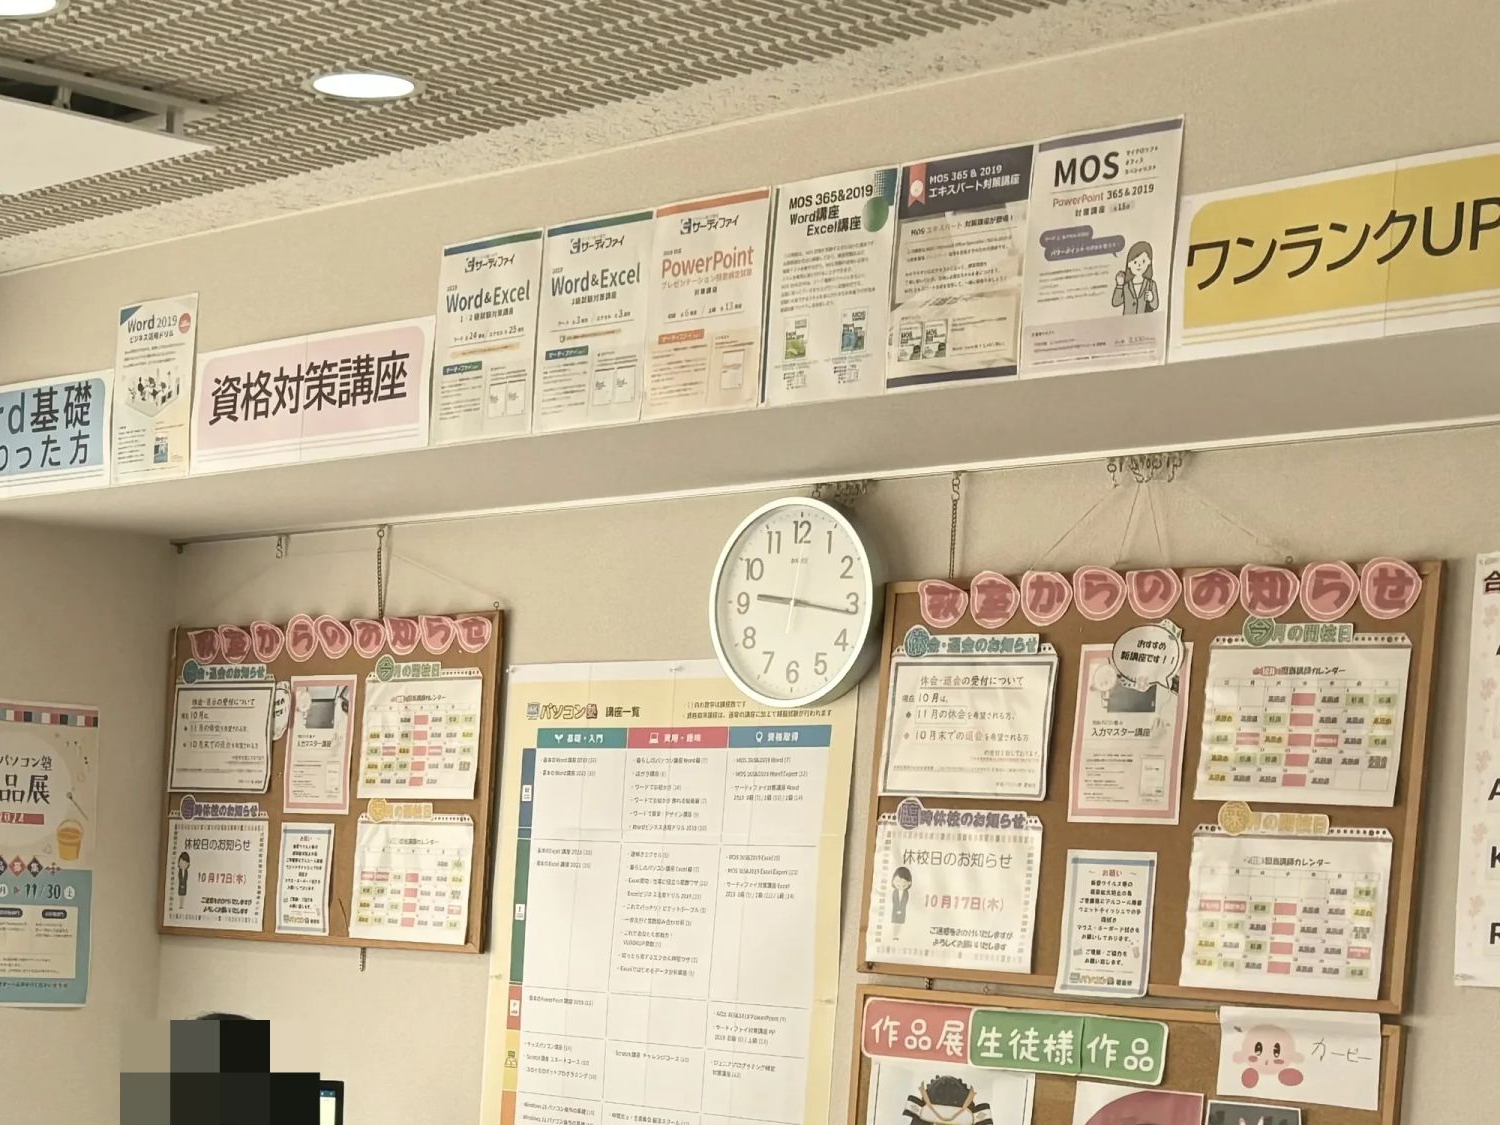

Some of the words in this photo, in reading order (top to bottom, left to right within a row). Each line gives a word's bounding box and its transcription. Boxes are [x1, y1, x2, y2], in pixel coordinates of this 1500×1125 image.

[930, 173, 949, 185] MOS
[951, 170, 968, 181] 365
[980, 164, 1003, 177] 2019
[1054, 151, 1119, 187] MOS
[789, 195, 813, 210] MOS
[815, 184, 874, 206] 365&2019
[928, 174, 1020, 198] エキスパート対策講座
[1053, 192, 1104, 208] PowerPoint
[1107, 183, 1154, 200] 365&2019
[692, 214, 740, 233] サーティファイ
[790, 205, 840, 226] Word講座
[806, 216, 862, 237] Excel講座
[581, 235, 625, 253] サーティファイ
[1187, 198, 1500, 291] ワンランクUP
[475, 253, 516, 271] サーティファイ
[662, 246, 754, 279] PowerPoint
[551, 262, 641, 296] Word&Excel
[446, 279, 530, 313] Word&Excel
[127, 315, 155, 333] Word
[156, 315, 178, 329] 2019
[208, 350, 410, 426] 資格対策講座
[767, 531, 781, 554] 11
[793, 520, 811, 544] 12
[827, 531, 832, 554] 1
[745, 558, 764, 581] 10
[840, 555, 853, 579] 2
[737, 592, 749, 615] 9
[846, 592, 859, 615] 3
[742, 626, 756, 649] 8
[834, 628, 848, 652] 4
[762, 651, 775, 674] 7
[786, 660, 799, 684] 6
[814, 652, 828, 675] 5
[606, 707, 641, 718] 講座一覧
[1091, 727, 1151, 738] 入力マスター講座
[184, 838, 252, 852] 休校日のお知らせ
[903, 849, 1013, 869] 休校日のお知らせ
[25, 883, 61, 899] 11/30
[871, 1015, 965, 1057] 作品展
